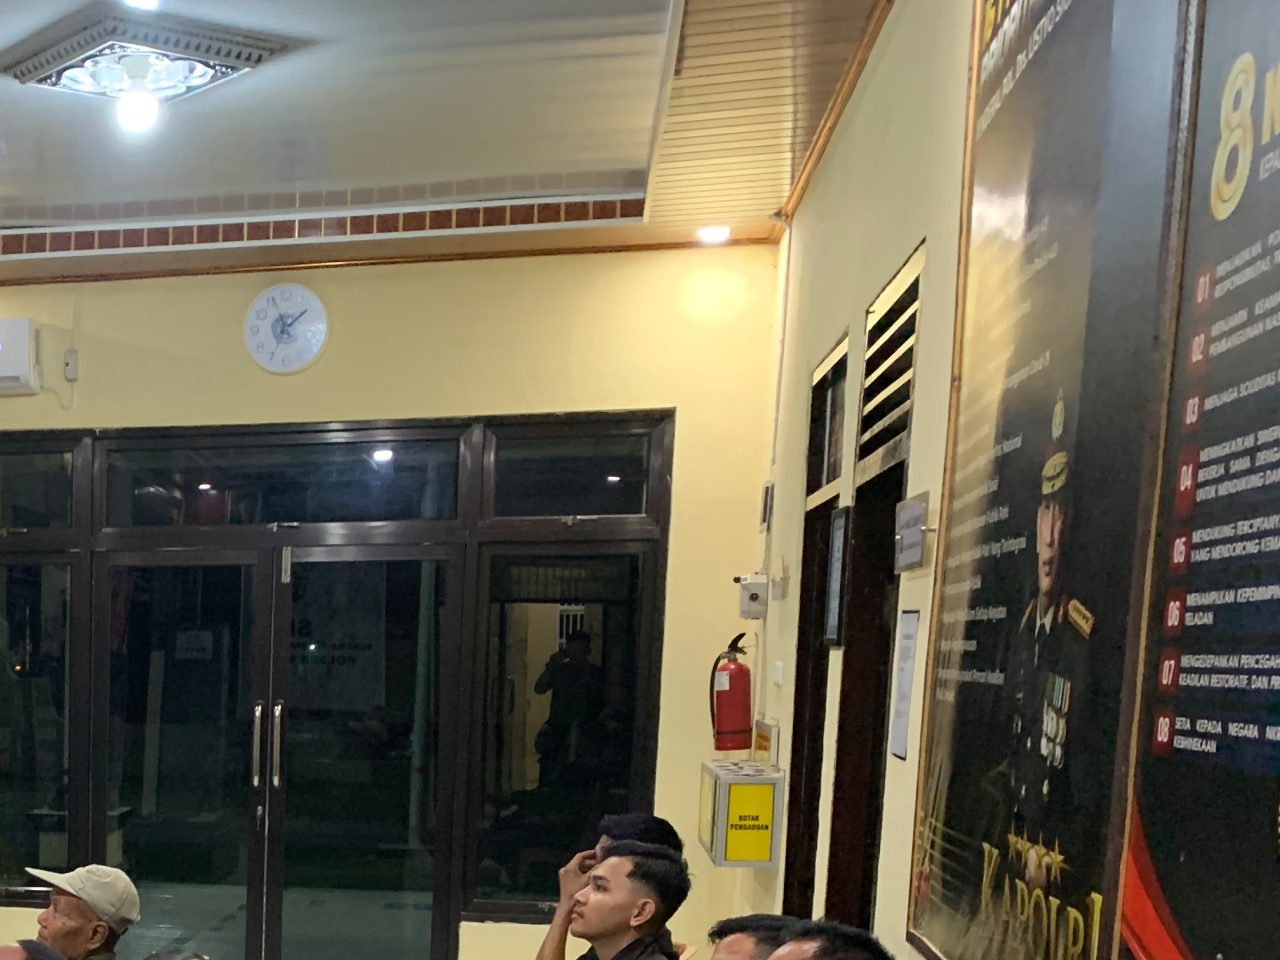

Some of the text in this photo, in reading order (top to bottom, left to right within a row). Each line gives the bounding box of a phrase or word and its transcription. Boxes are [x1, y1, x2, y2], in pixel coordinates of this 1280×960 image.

[1209, 52, 1257, 221] 8
[1196, 273, 1210, 304] 01
[1186, 397, 1199, 425] 03
[1180, 464, 1193, 491] 04
[1173, 538, 1187, 563] 05
[1167, 601, 1180, 626] 06
[1162, 660, 1175, 685] 07
[1251, 675, 1268, 689] DAN
[1157, 717, 1170, 742] 08
[1196, 719, 1222, 734] KEPADA
[1228, 722, 1259, 738] NEGARA
[730, 823, 769, 831] PENGADUAN
[738, 814, 760, 822] KOTAK
